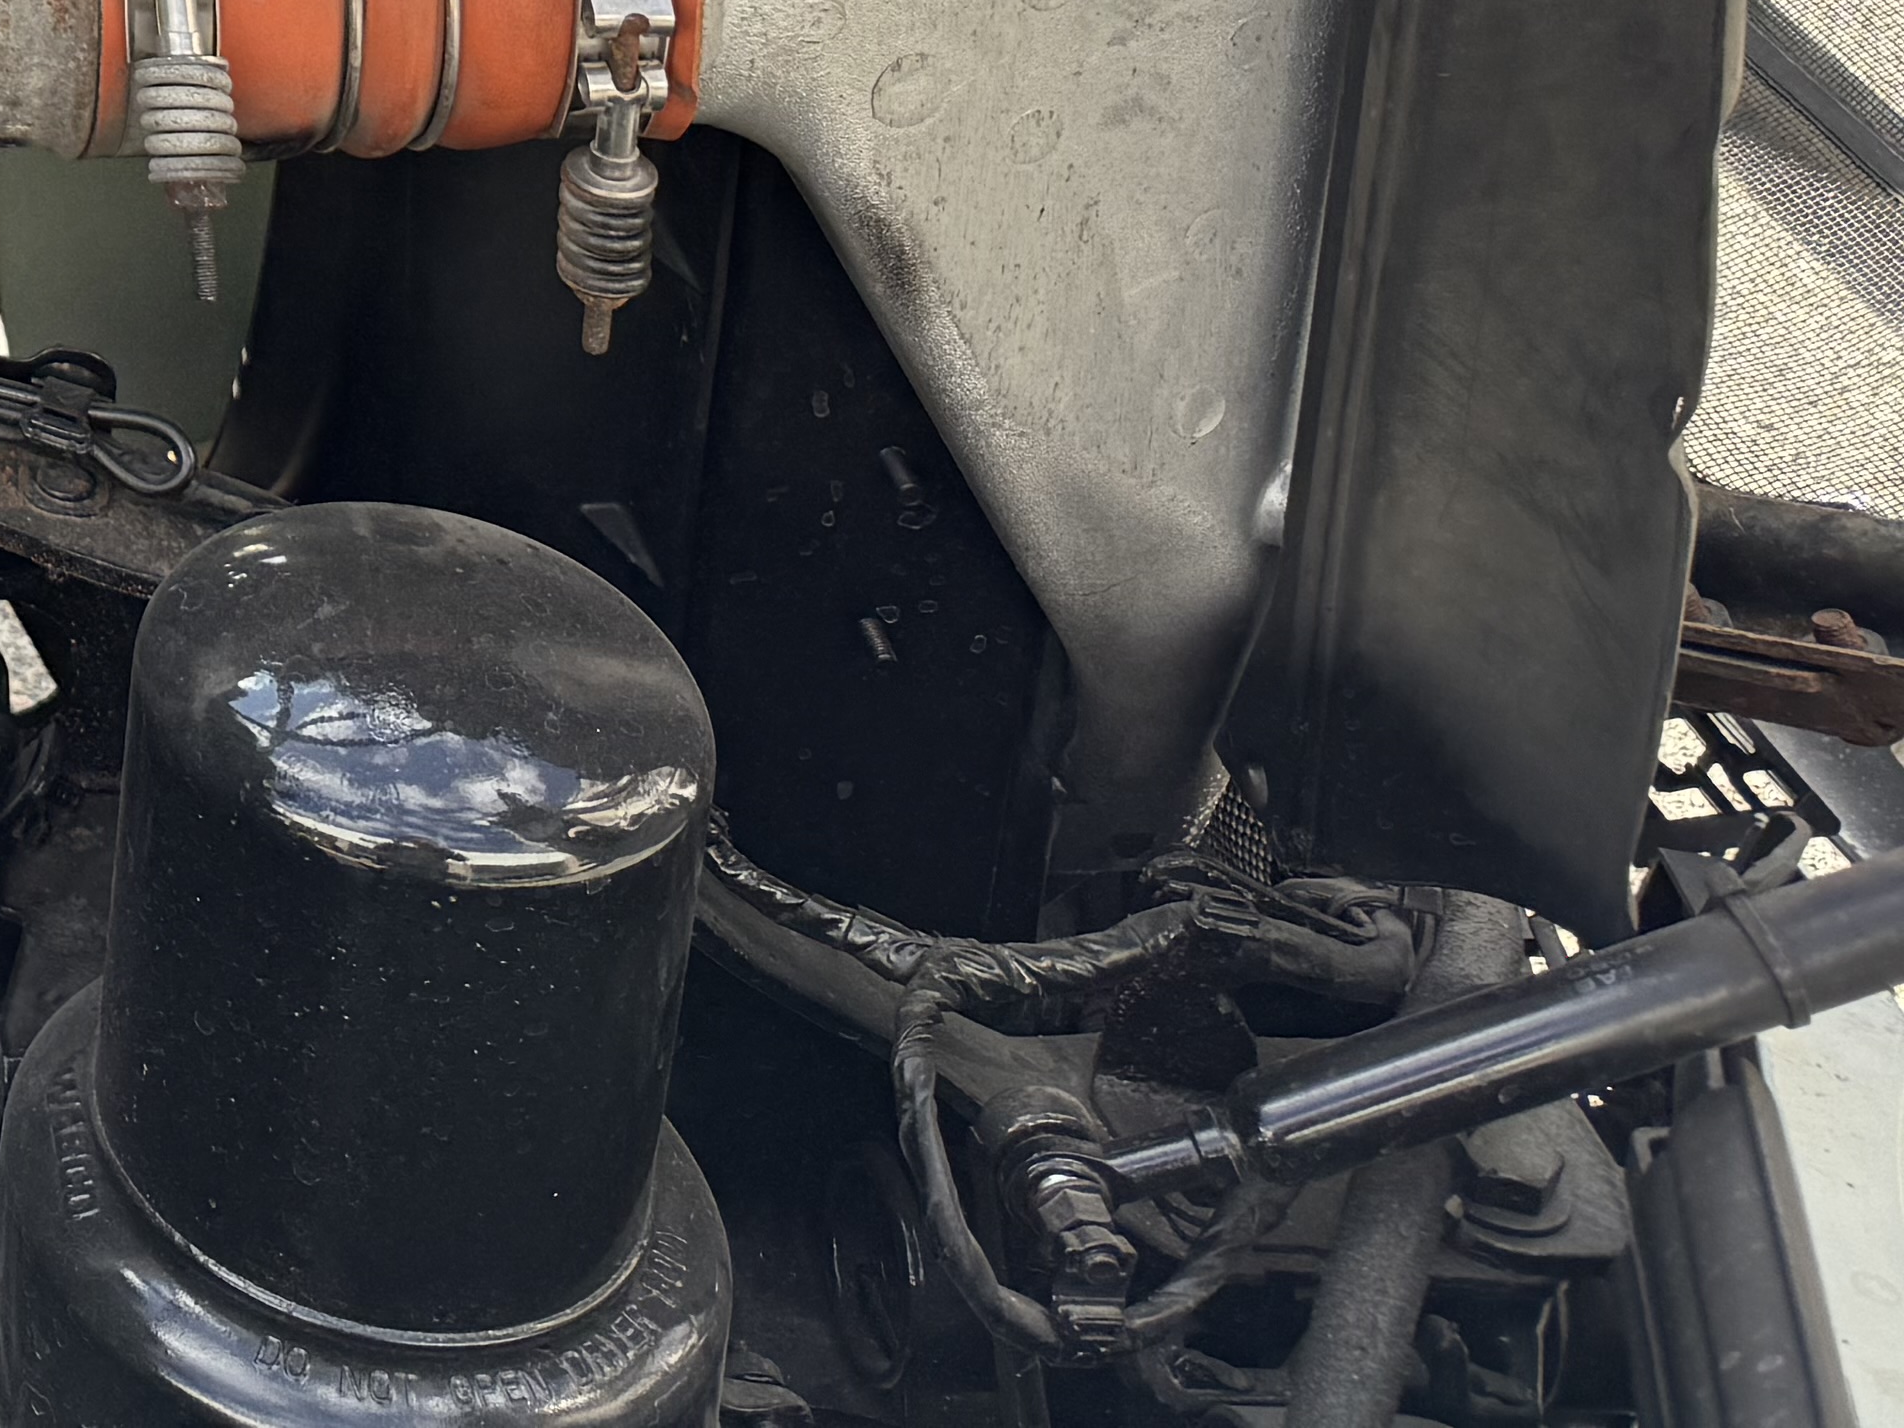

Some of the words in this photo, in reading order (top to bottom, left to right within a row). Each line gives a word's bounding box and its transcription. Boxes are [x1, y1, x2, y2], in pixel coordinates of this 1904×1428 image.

[253, 1335, 312, 1382] DO
[338, 1365, 419, 1406] NOT
[448, 1368, 556, 1412] OPEN
